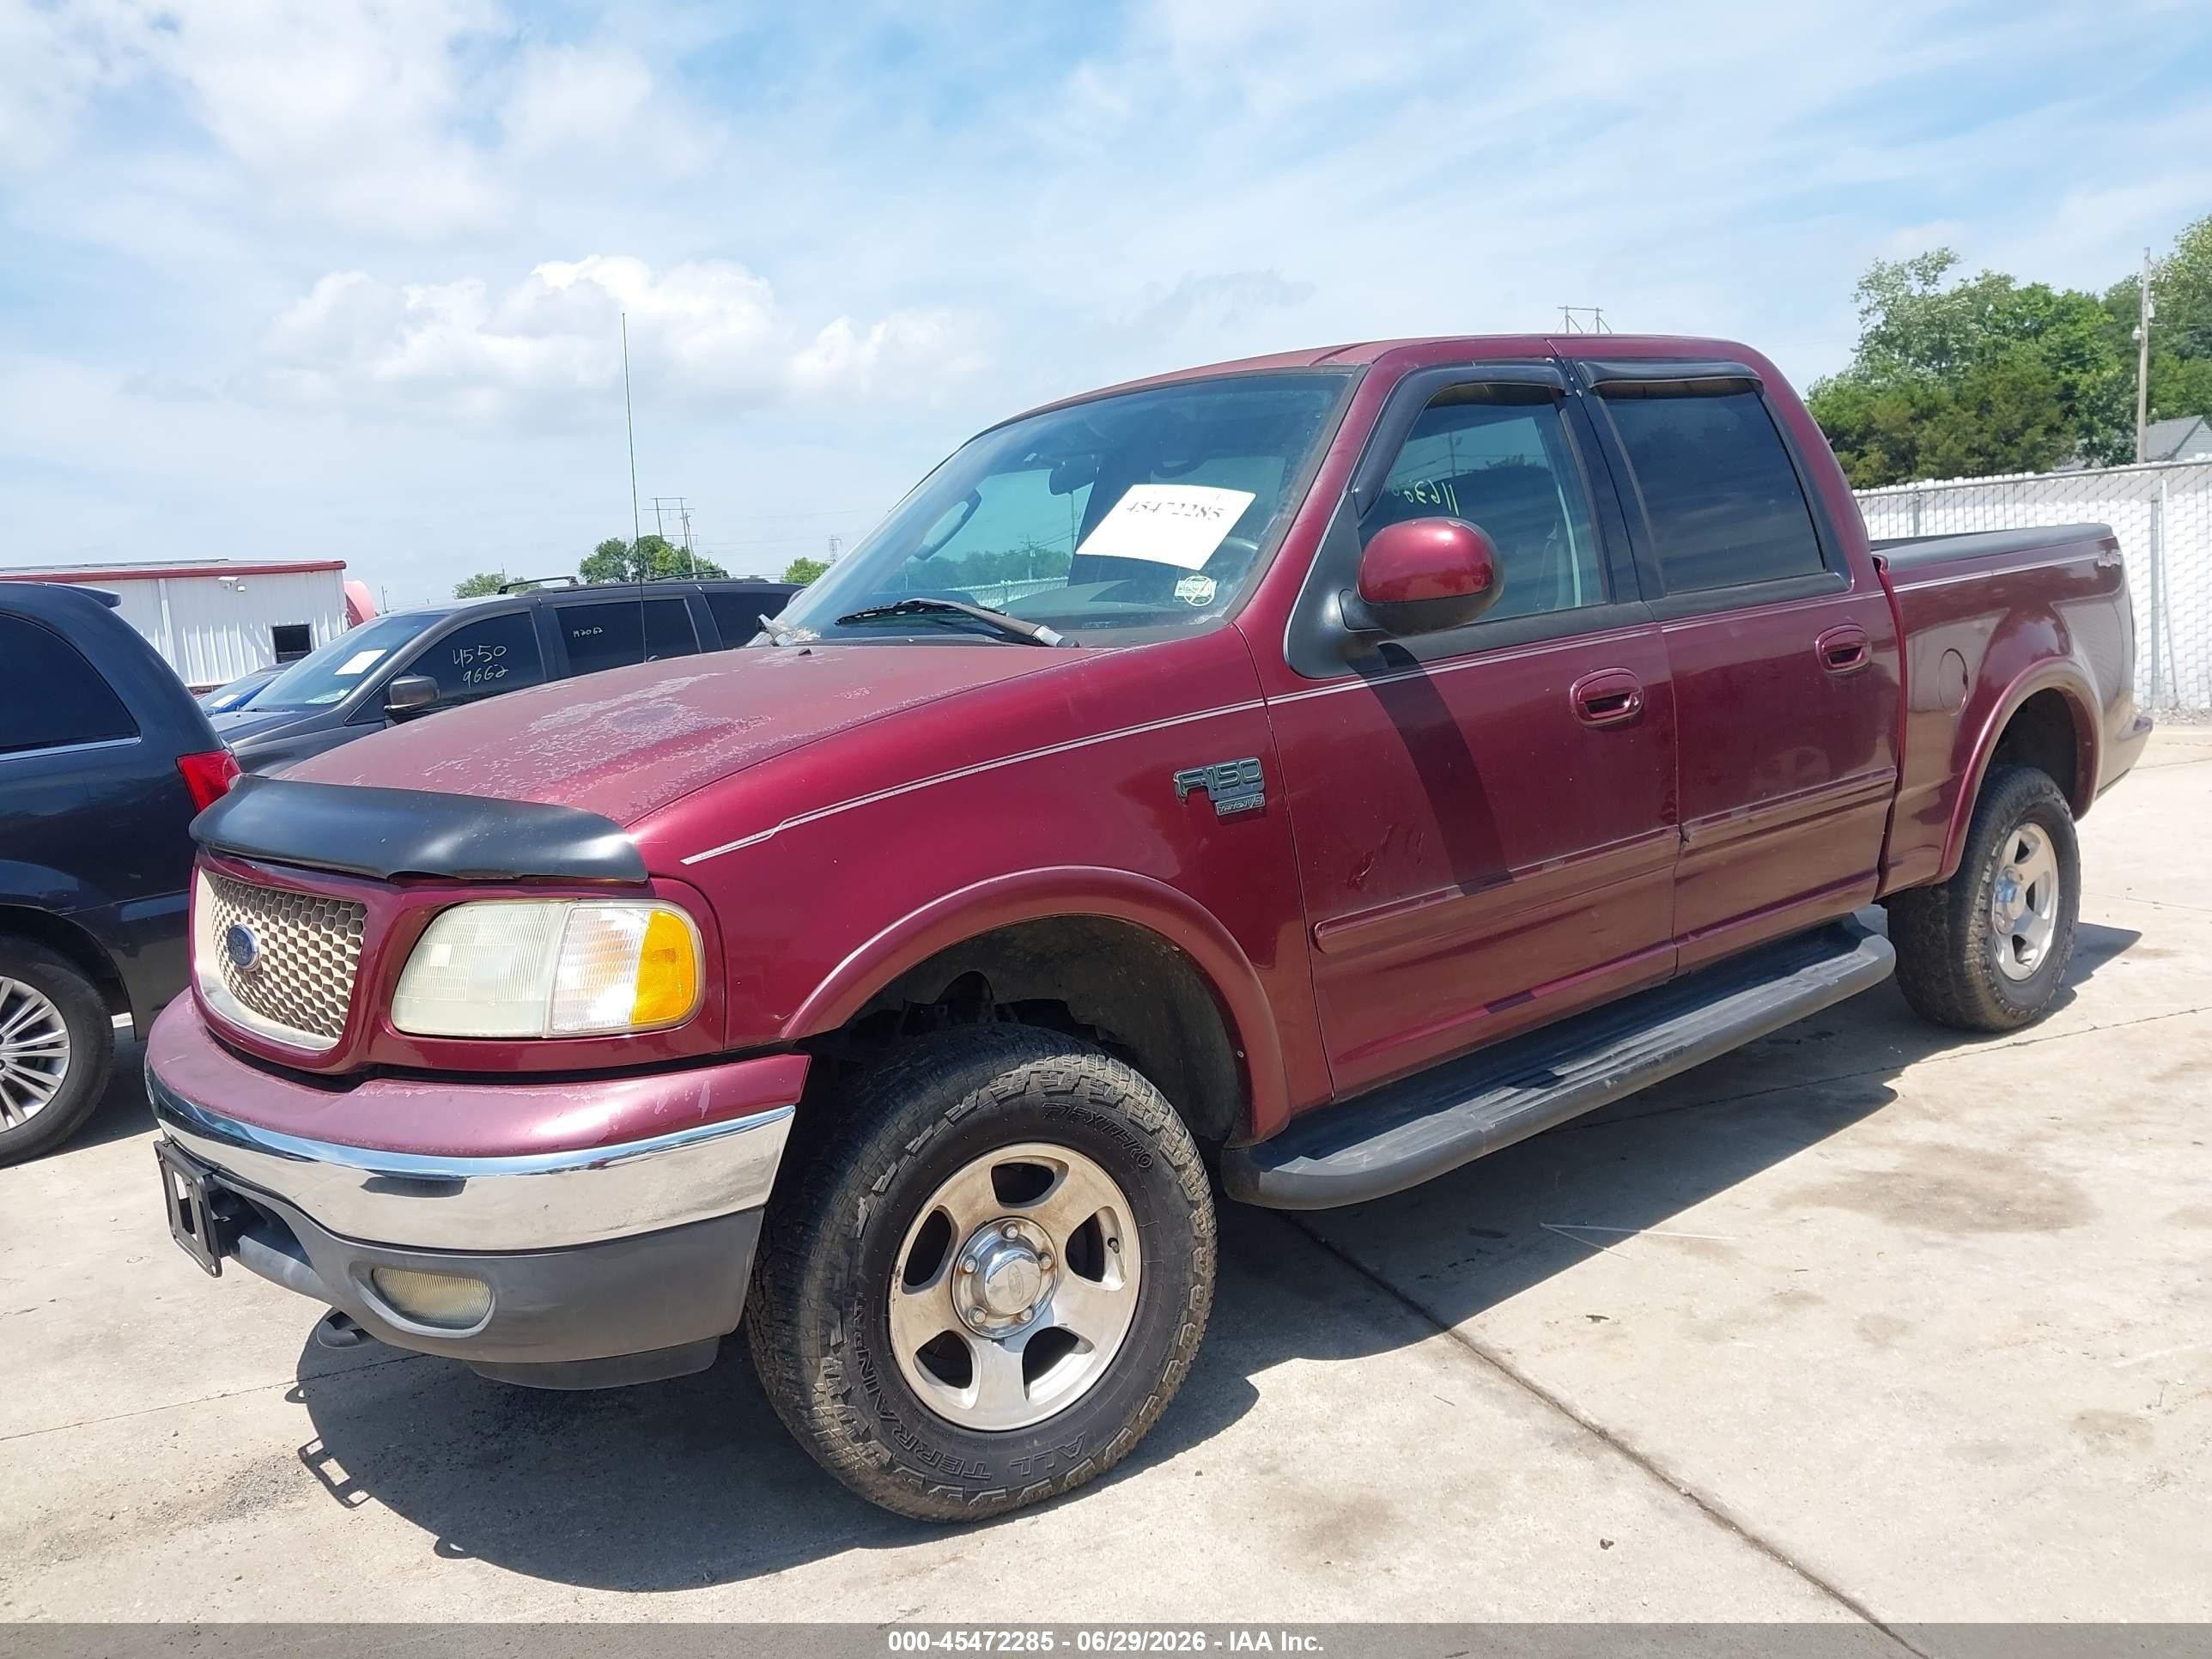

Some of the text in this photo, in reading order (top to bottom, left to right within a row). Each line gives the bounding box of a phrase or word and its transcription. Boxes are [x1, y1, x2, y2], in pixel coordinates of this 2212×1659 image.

[453, 645, 507, 668] 4550
[462, 664, 509, 689] 9662
[859, 1348, 992, 1481] TERRAIN
[1009, 1431, 1086, 1478] ALL
